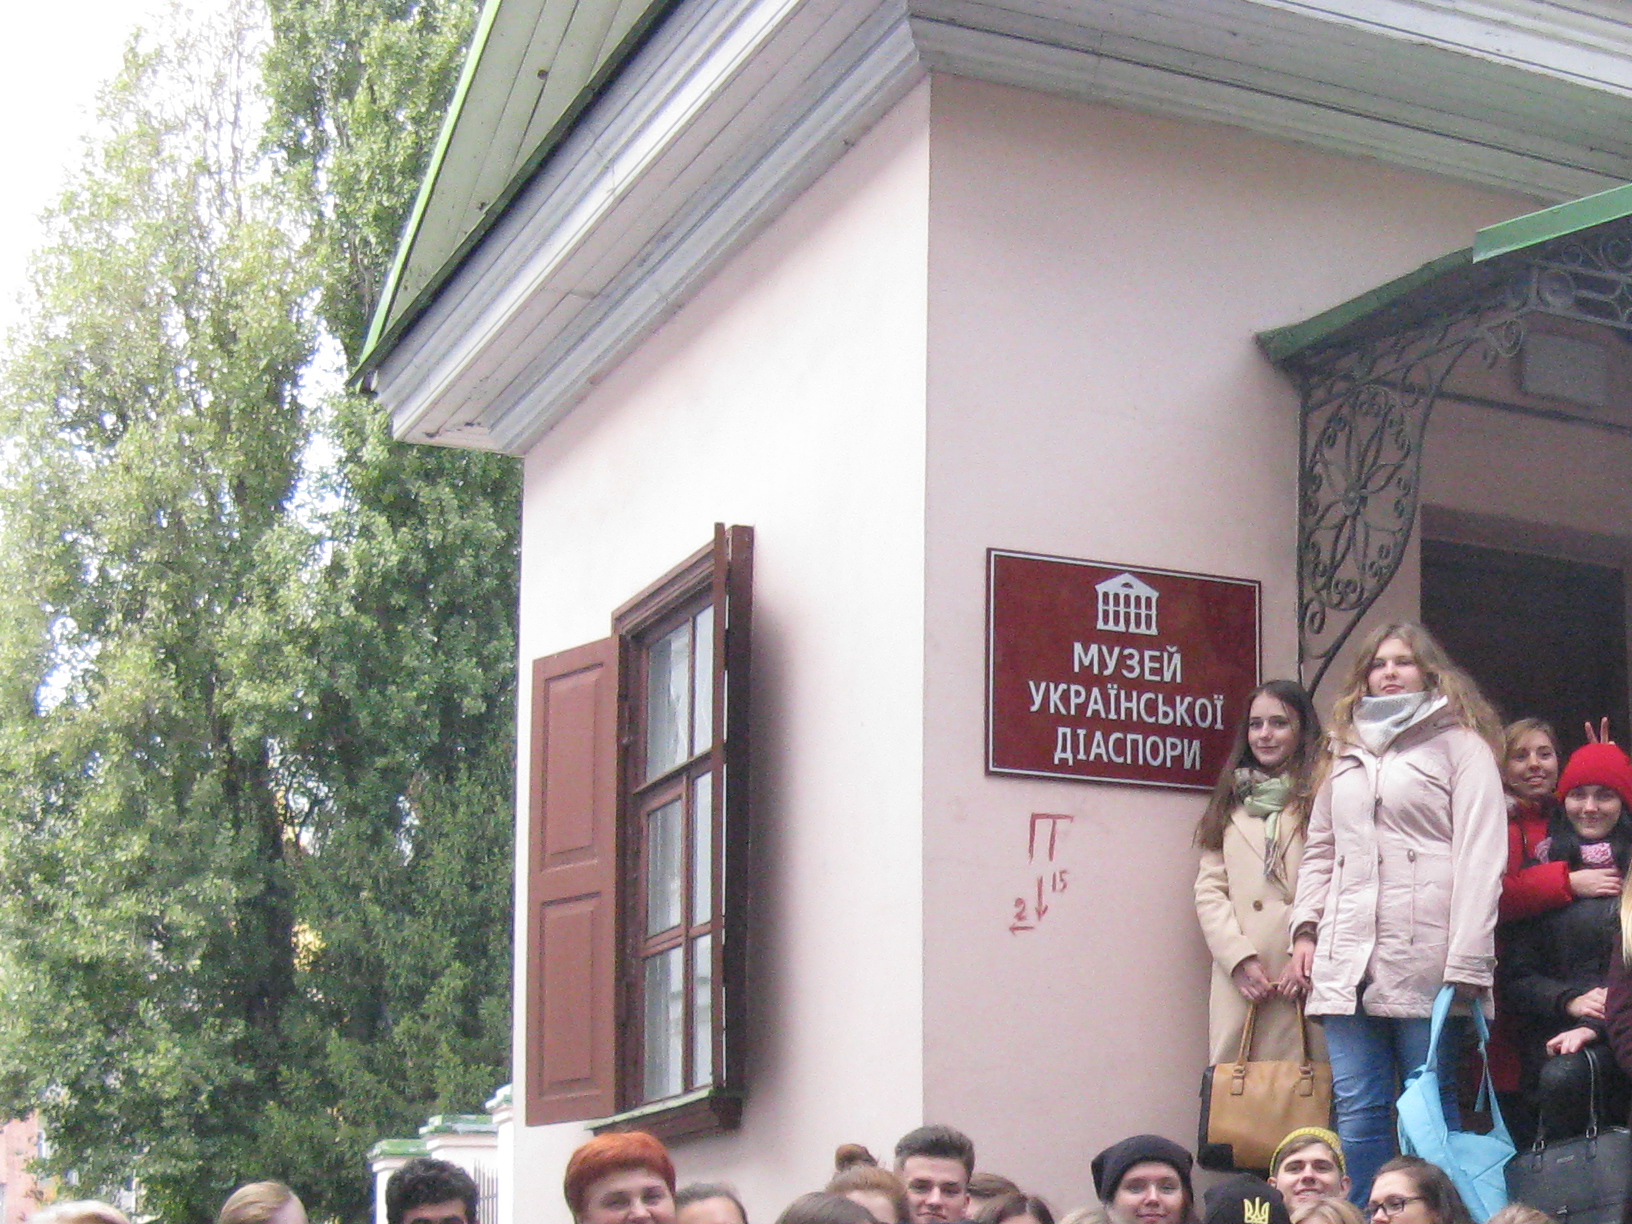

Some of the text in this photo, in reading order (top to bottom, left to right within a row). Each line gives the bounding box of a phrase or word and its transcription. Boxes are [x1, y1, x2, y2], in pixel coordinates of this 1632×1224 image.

[1073, 642, 1182, 683] МУЗЕЙ
[1028, 680, 1225, 731] УКРАЇНСЬКОЇ
[1053, 726, 1201, 770] ДІАСПОРИ
